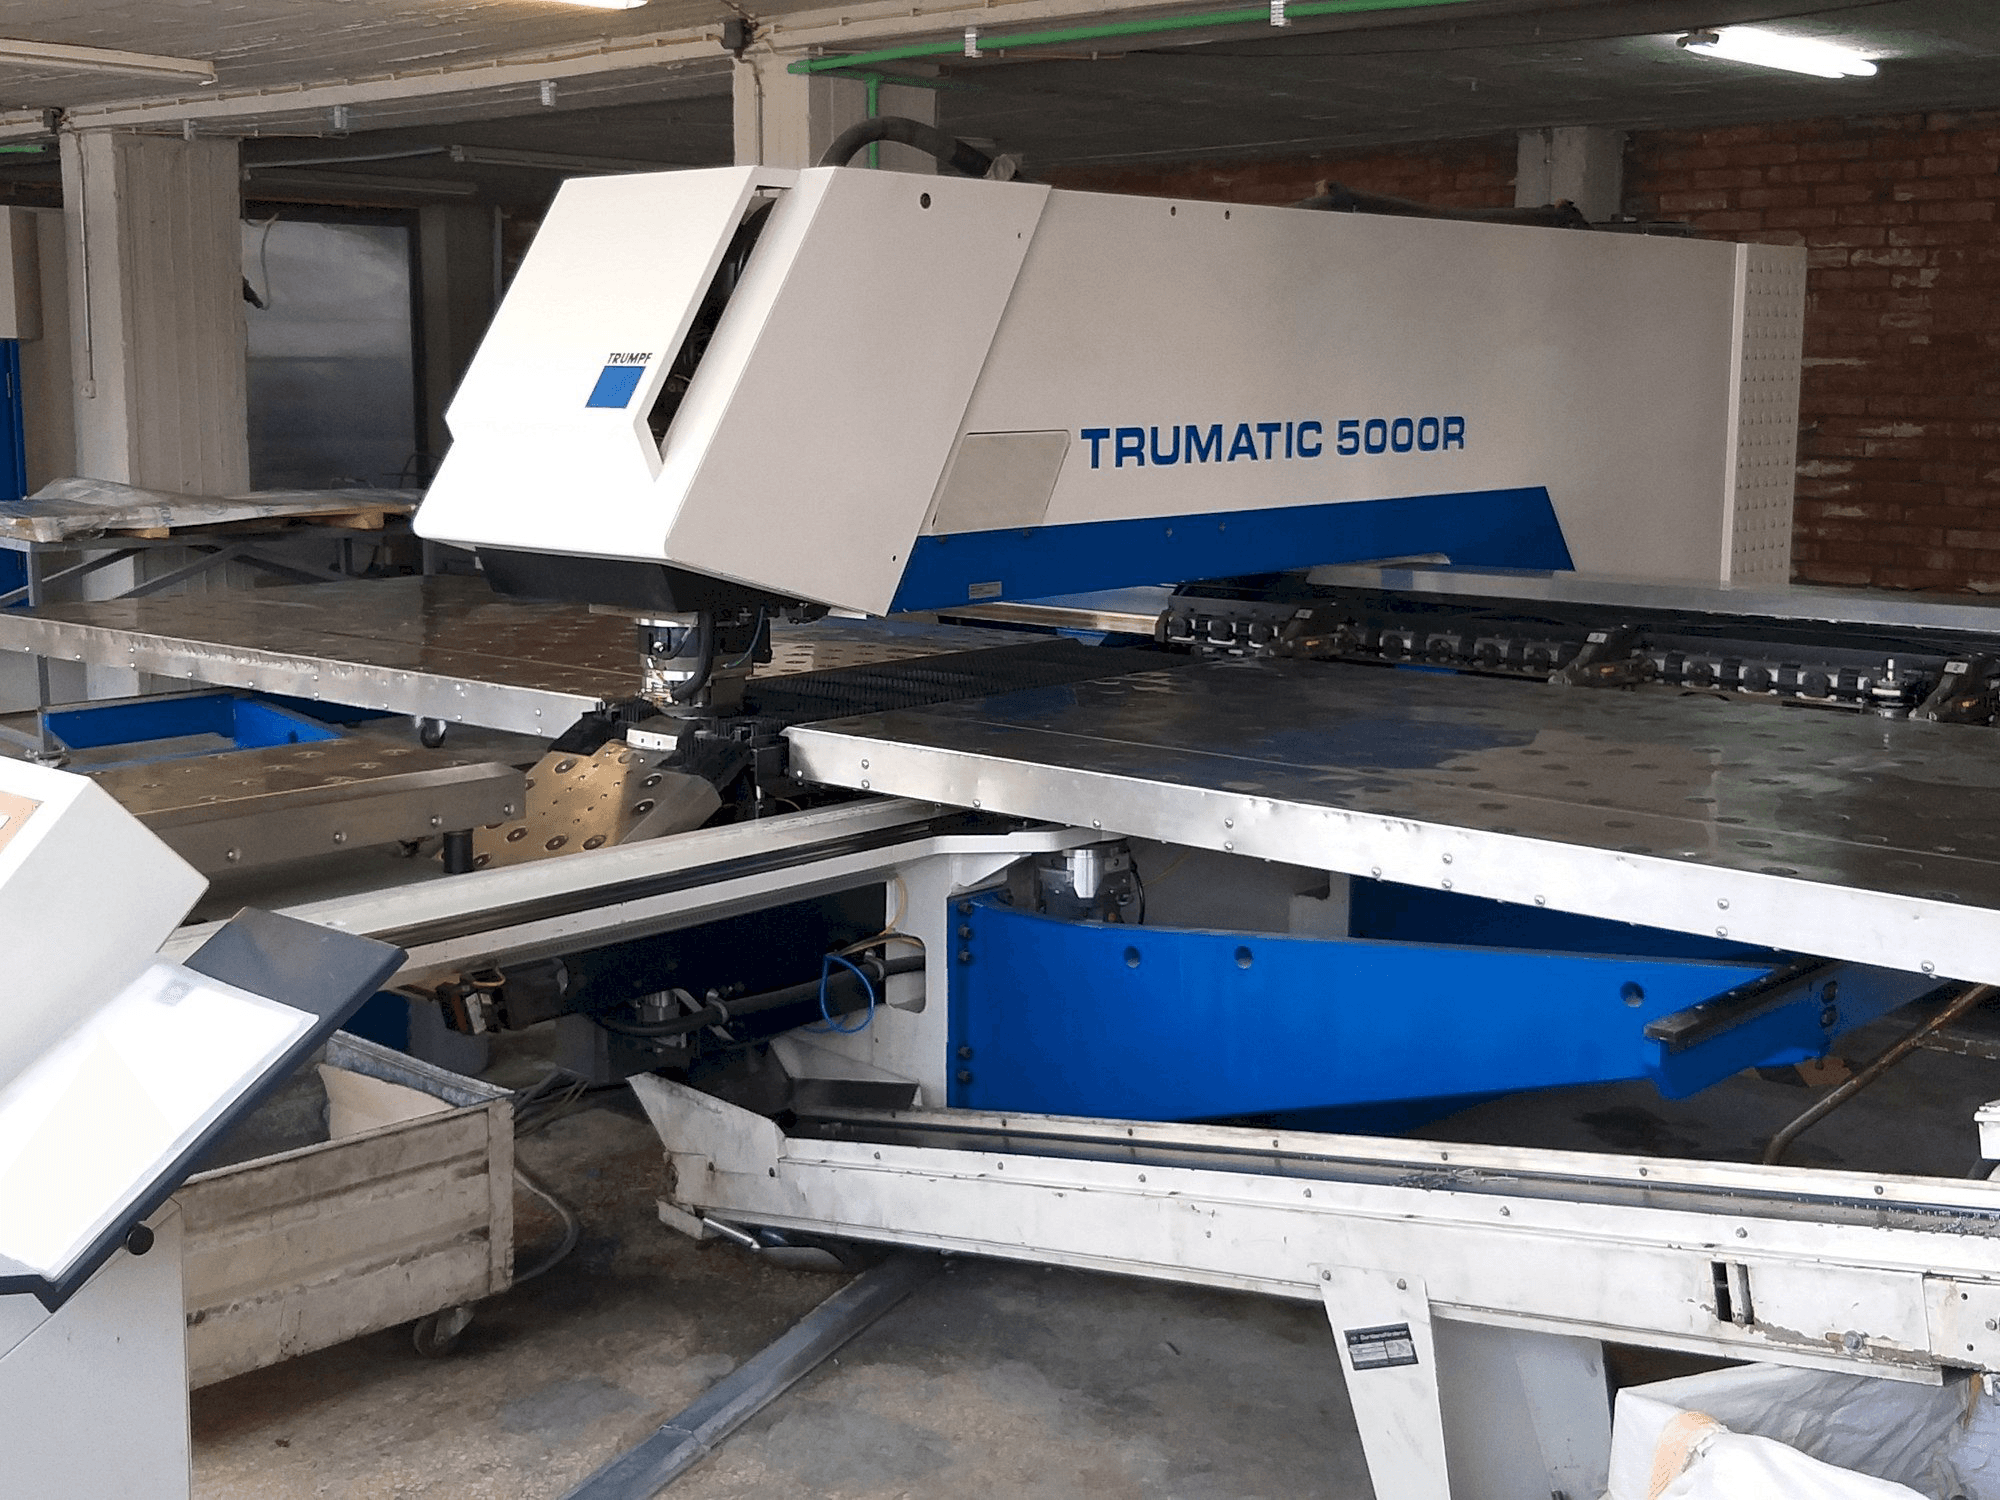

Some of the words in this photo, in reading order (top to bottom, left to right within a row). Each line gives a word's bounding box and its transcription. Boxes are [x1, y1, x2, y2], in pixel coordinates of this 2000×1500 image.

[607, 352, 653, 364] TRUMPF
[1080, 420, 1323, 469] TRUMATIC
[1336, 415, 1465, 456] 5000R
